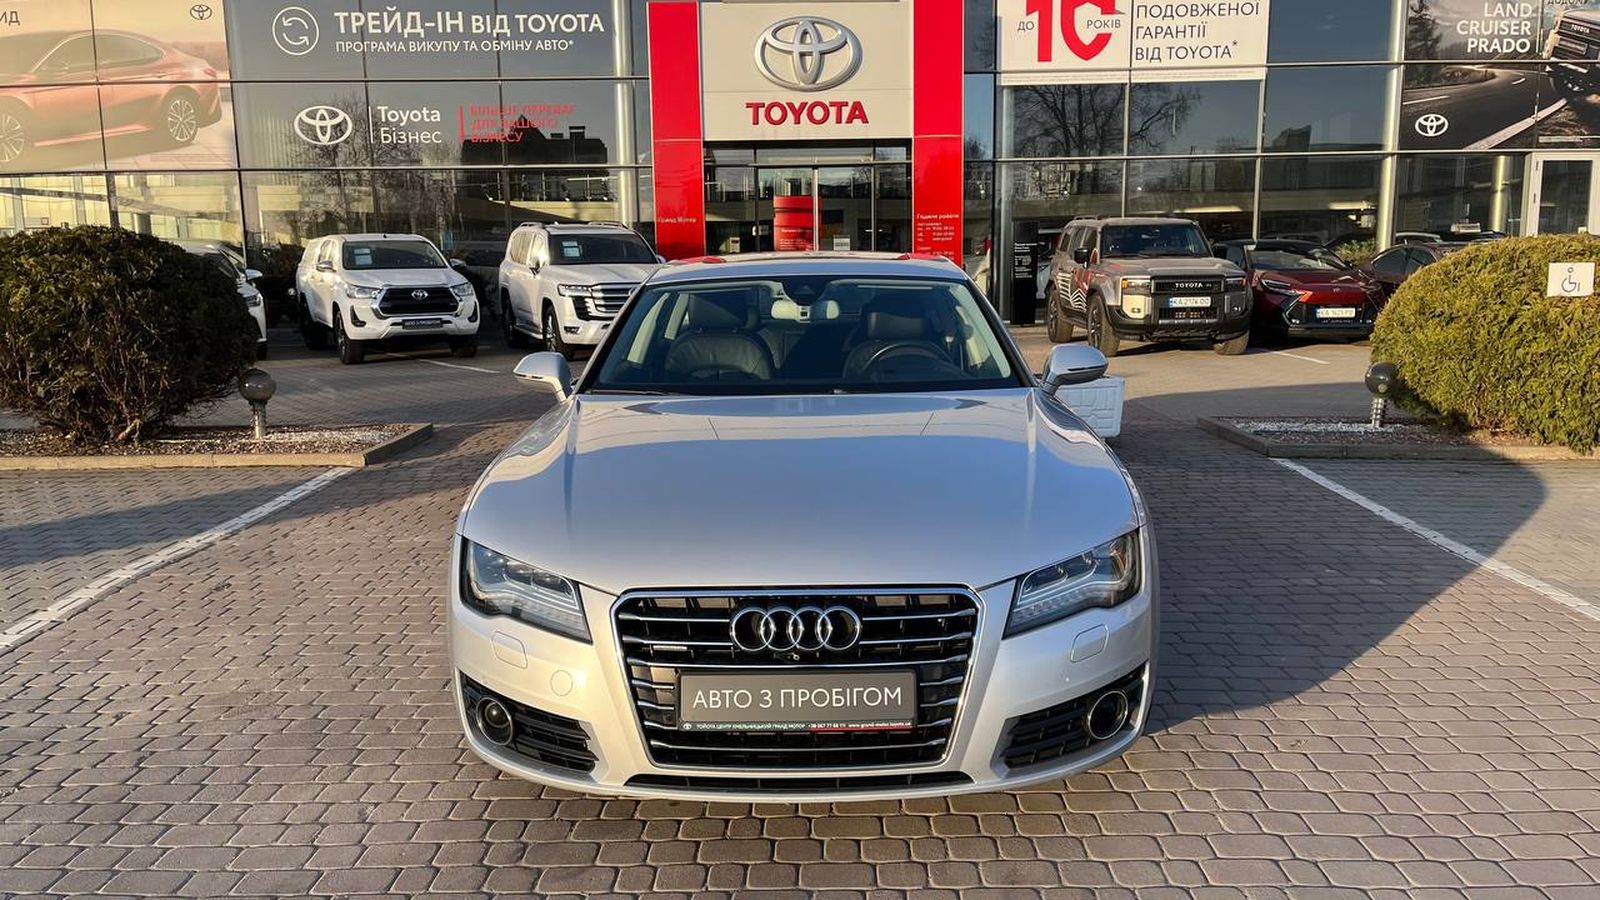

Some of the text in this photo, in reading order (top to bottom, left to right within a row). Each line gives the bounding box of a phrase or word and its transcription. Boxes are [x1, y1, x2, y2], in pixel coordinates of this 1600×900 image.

[1484, 3, 1532, 17] LAND
[334, 6, 604, 38] ТРЕЙД-ІН ВІД TOYOTA
[1017, 20, 1035, 32] ДО
[1086, 19, 1121, 29] РОКІВ
[1457, 20, 1531, 35] CRUISER
[1135, 22, 1208, 40] ГАРАНТІЇ
[336, 41, 406, 52] ПРОГРАМА
[408, 41, 460, 52] ВИКУПУ
[463, 41, 478, 51] ТА
[481, 40, 532, 51] ОБМІНУ
[1467, 38, 1531, 53] PRADO
[1135, 46, 1162, 63] ВІД
[377, 106, 441, 125] Toyota
[745, 101, 869, 125] TOYOTA
[380, 127, 442, 144] Бізнес
[692, 687, 902, 709] АВТО З ПРОБІГОМ
